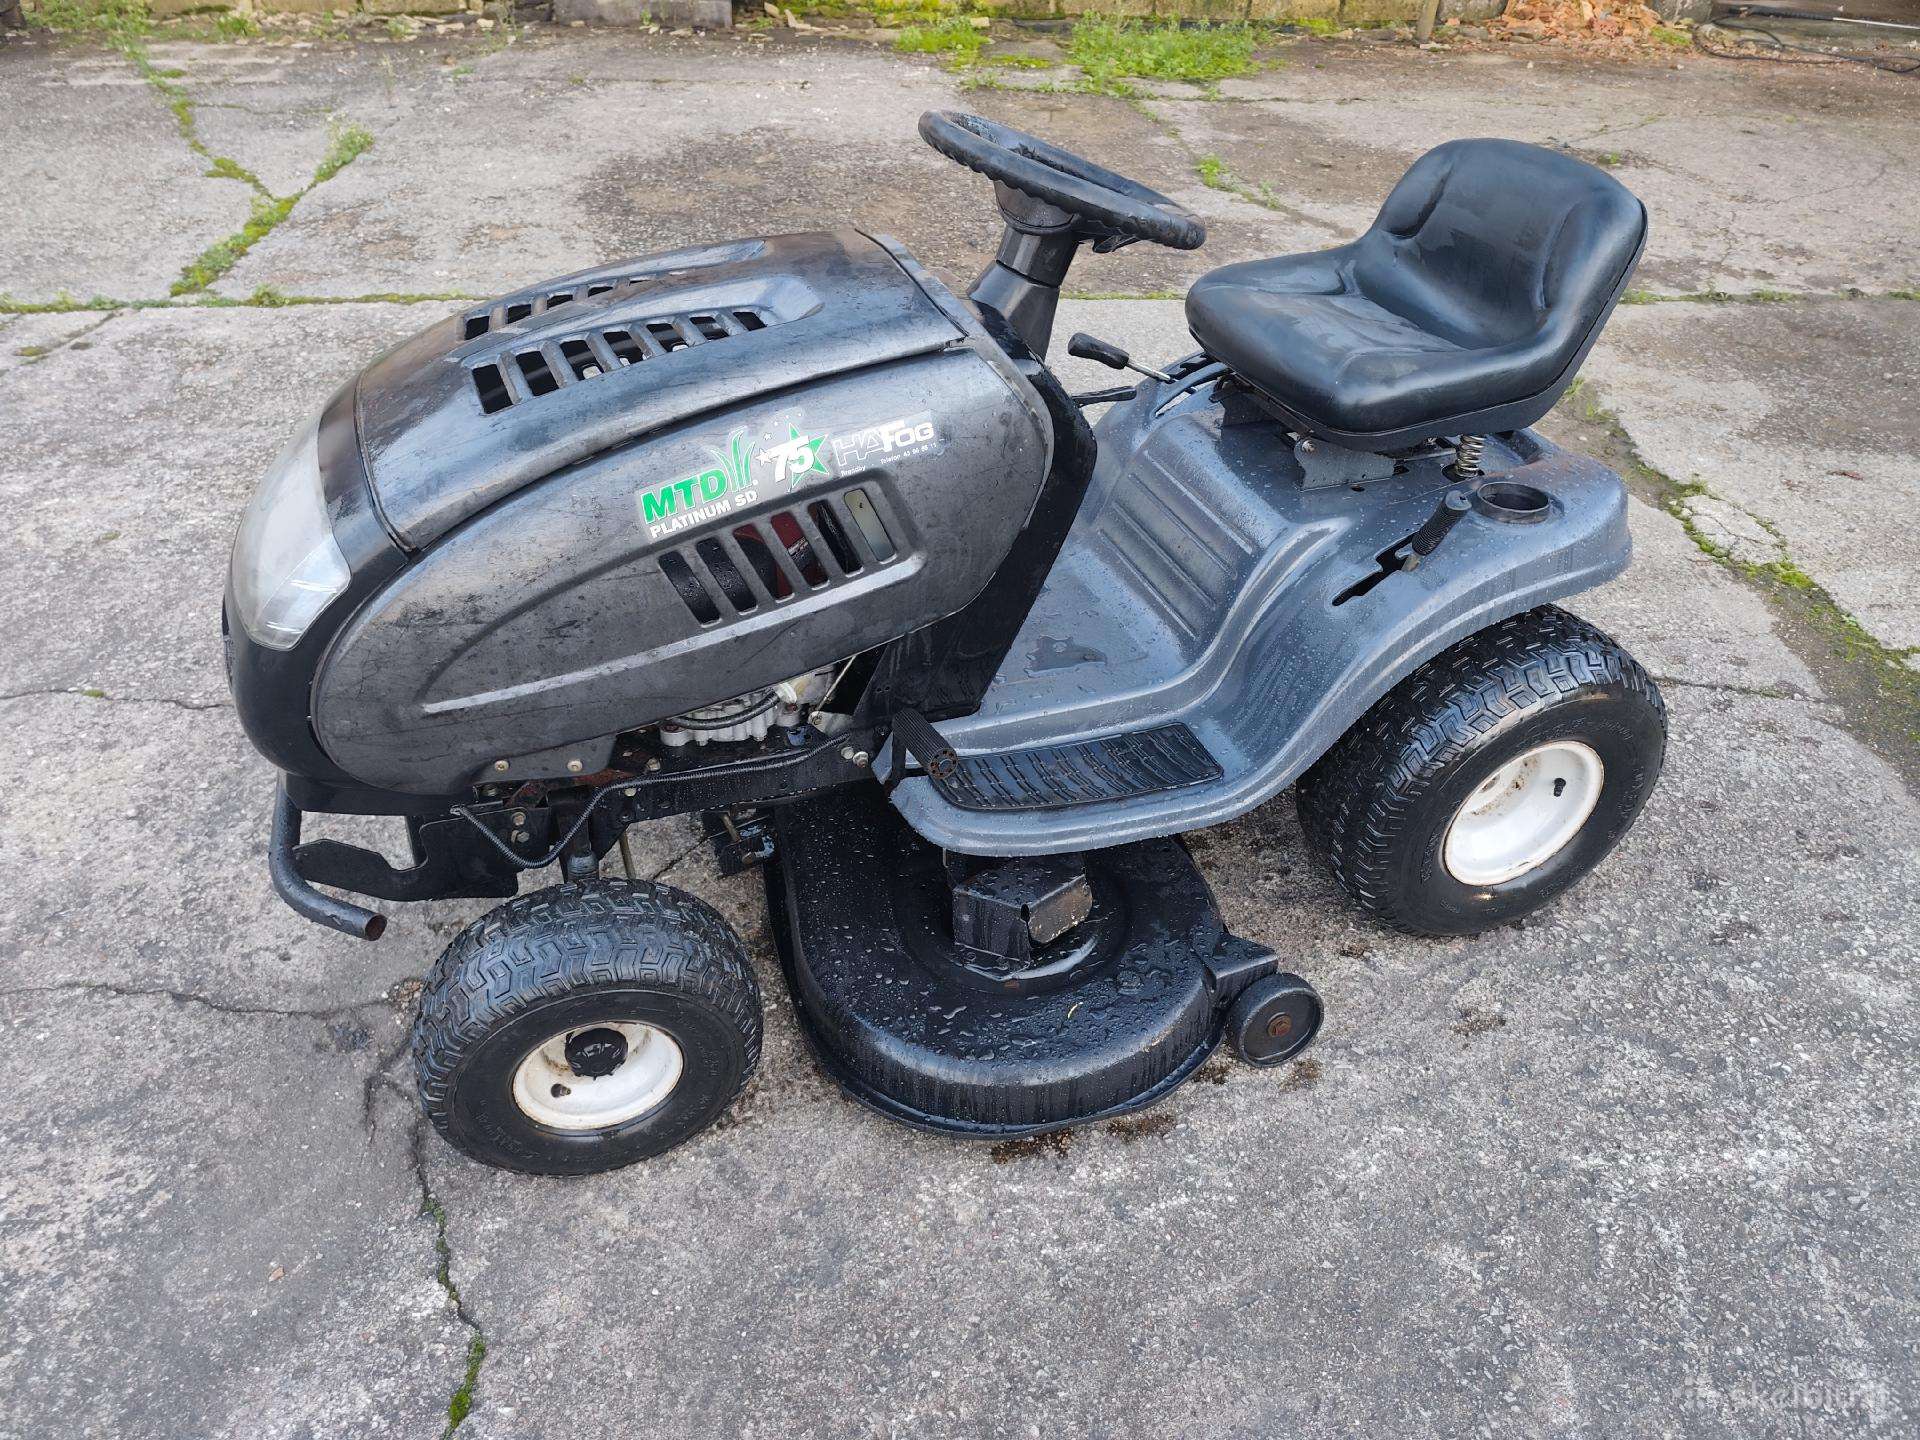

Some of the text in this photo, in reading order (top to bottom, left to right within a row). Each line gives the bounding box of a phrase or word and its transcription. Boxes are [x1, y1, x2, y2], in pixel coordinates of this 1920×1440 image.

[765, 434, 815, 484] 75
[831, 418, 935, 468] HAFOG
[640, 467, 729, 524] MTD
[649, 489, 759, 539] PLATINUM SD
